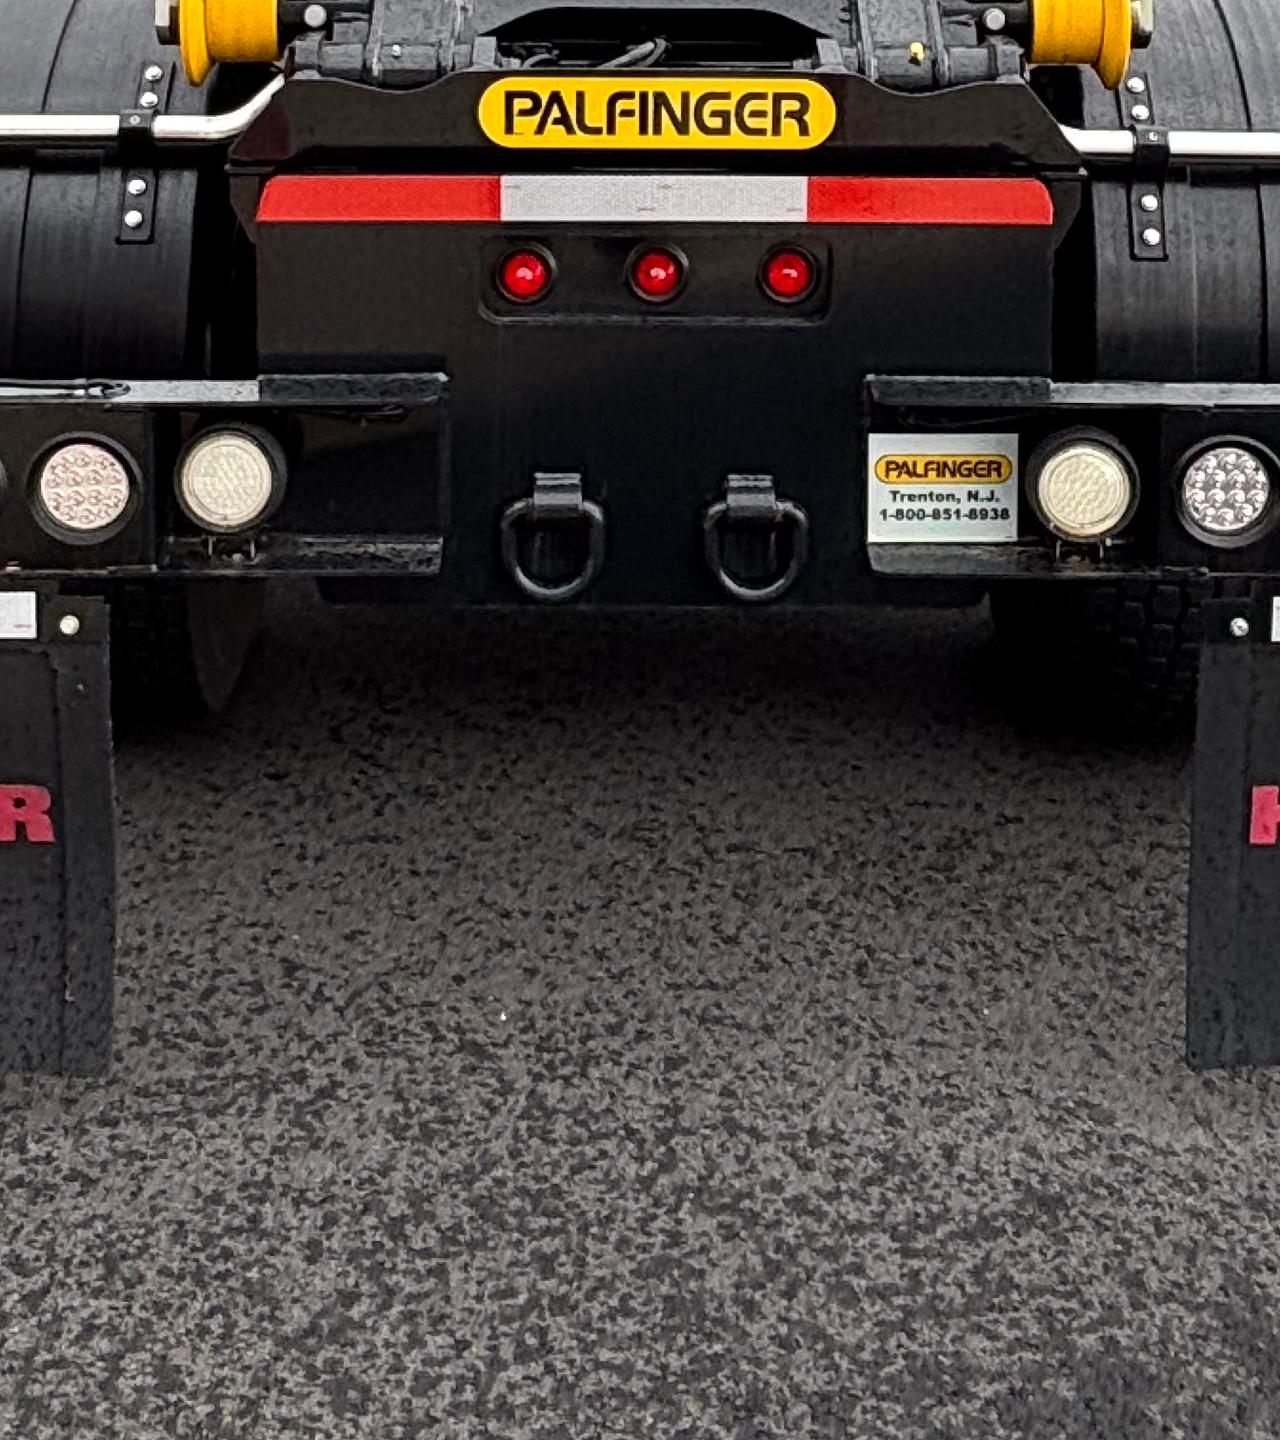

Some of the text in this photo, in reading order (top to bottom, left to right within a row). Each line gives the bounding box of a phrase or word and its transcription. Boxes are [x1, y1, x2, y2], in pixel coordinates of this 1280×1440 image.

[504, 90, 810, 136] PALFINGER
[885, 460, 1002, 478] PALFINGER
[889, 490, 1000, 504] Trenton, N.J.
[879, 507, 1010, 521] 1-800-851-8938
